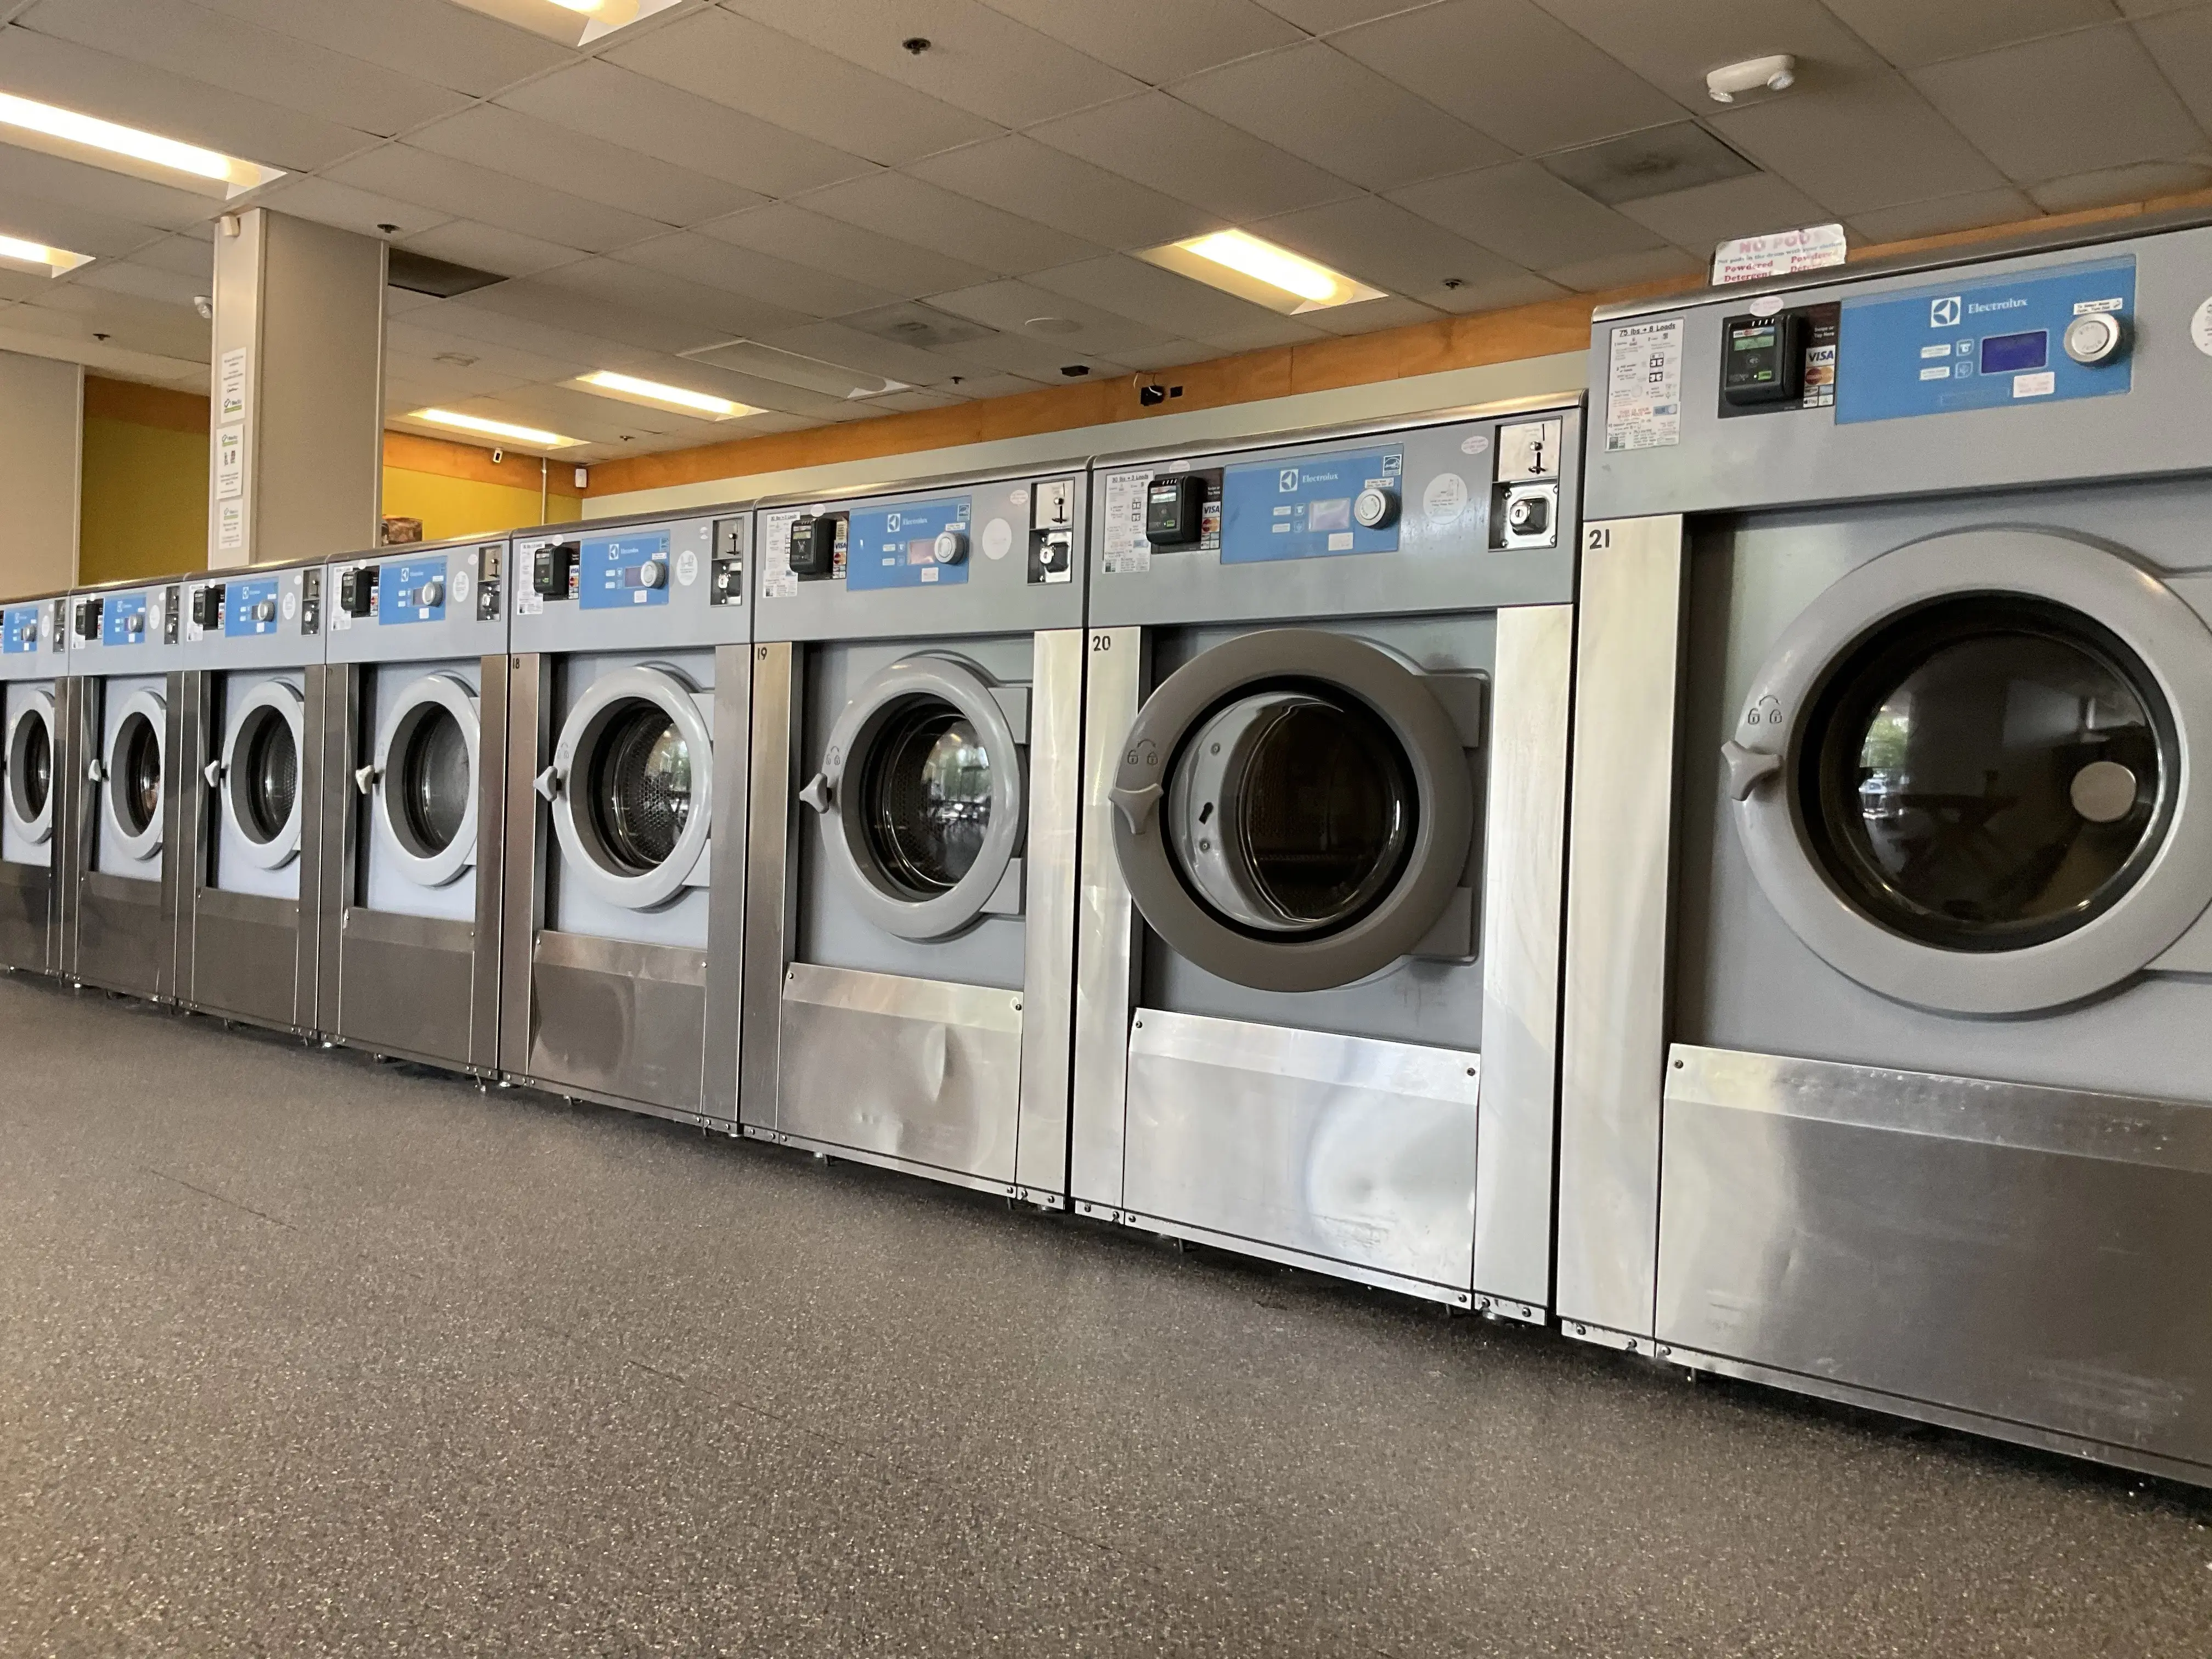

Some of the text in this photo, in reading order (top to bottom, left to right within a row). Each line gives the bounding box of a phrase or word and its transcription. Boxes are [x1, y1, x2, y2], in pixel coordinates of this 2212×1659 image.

[1740, 238, 1766, 253] NO
[1968, 298, 2028, 314] Electrolux
[1657, 323, 1675, 331] Loads
[1809, 350, 1833, 362] VISA
[1302, 473, 1339, 483] Electrolux
[1204, 505, 1220, 514] VISA
[1589, 529, 1610, 550] 21
[1093, 635, 1111, 651] 20
[758, 647, 767, 660] 19
[513, 658, 520, 669] 18
